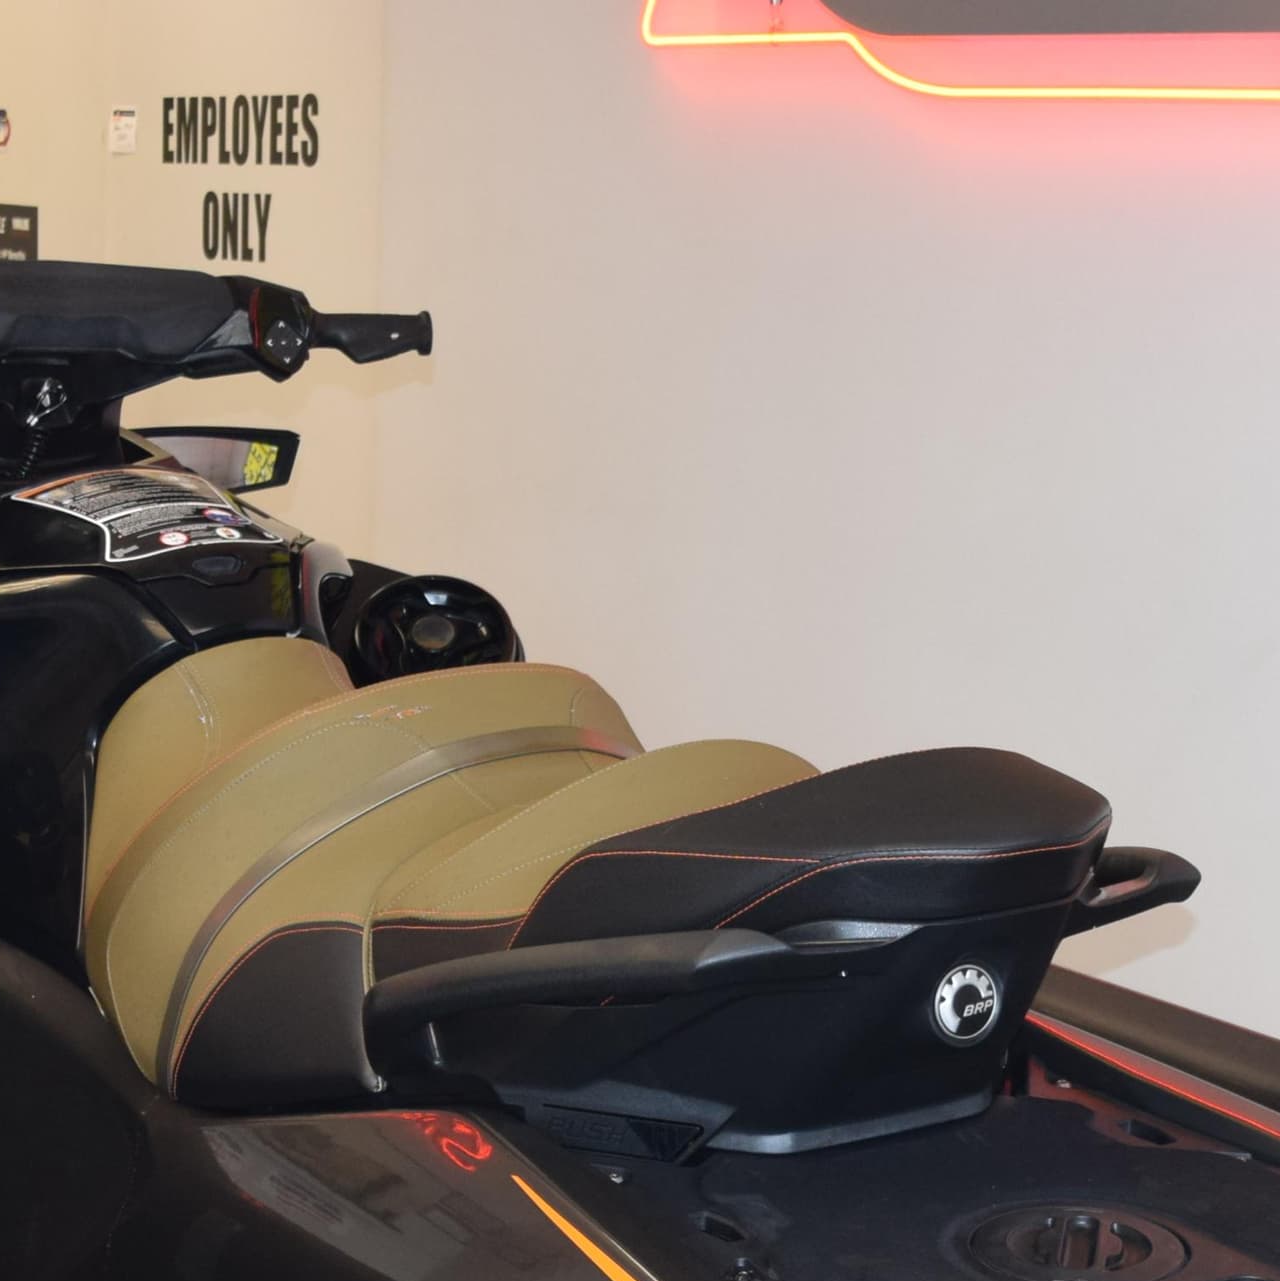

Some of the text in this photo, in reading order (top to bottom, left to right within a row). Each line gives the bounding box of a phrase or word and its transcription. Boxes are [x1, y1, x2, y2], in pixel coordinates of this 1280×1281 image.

[162, 94, 319, 167] EMPLOYEES
[202, 191, 272, 262] ONLY
[962, 999, 994, 1018] BRP
